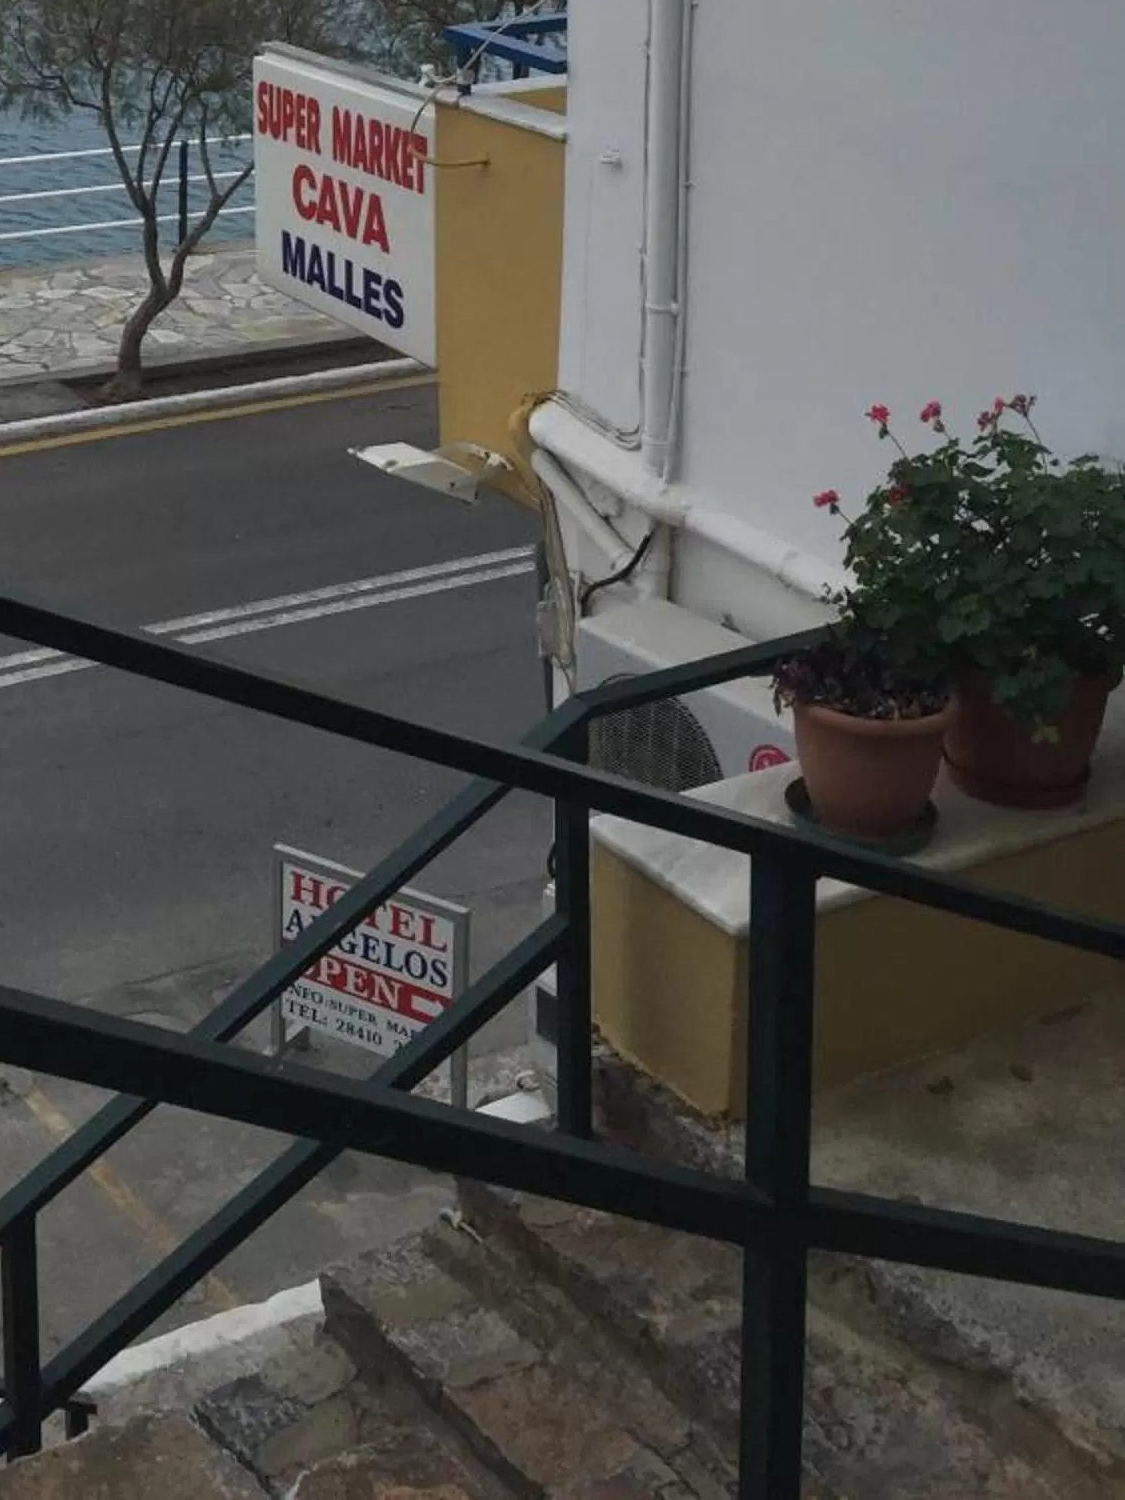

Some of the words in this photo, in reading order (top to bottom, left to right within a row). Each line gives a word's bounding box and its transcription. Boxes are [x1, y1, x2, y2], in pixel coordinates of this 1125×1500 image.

[257, 80, 321, 154] SUPER
[332, 105, 428, 194] MARKET
[292, 163, 390, 254] CAVA
[281, 229, 404, 329] MALLES
[285, 908, 448, 988] AGELOS
[303, 956, 403, 1011] PEN
